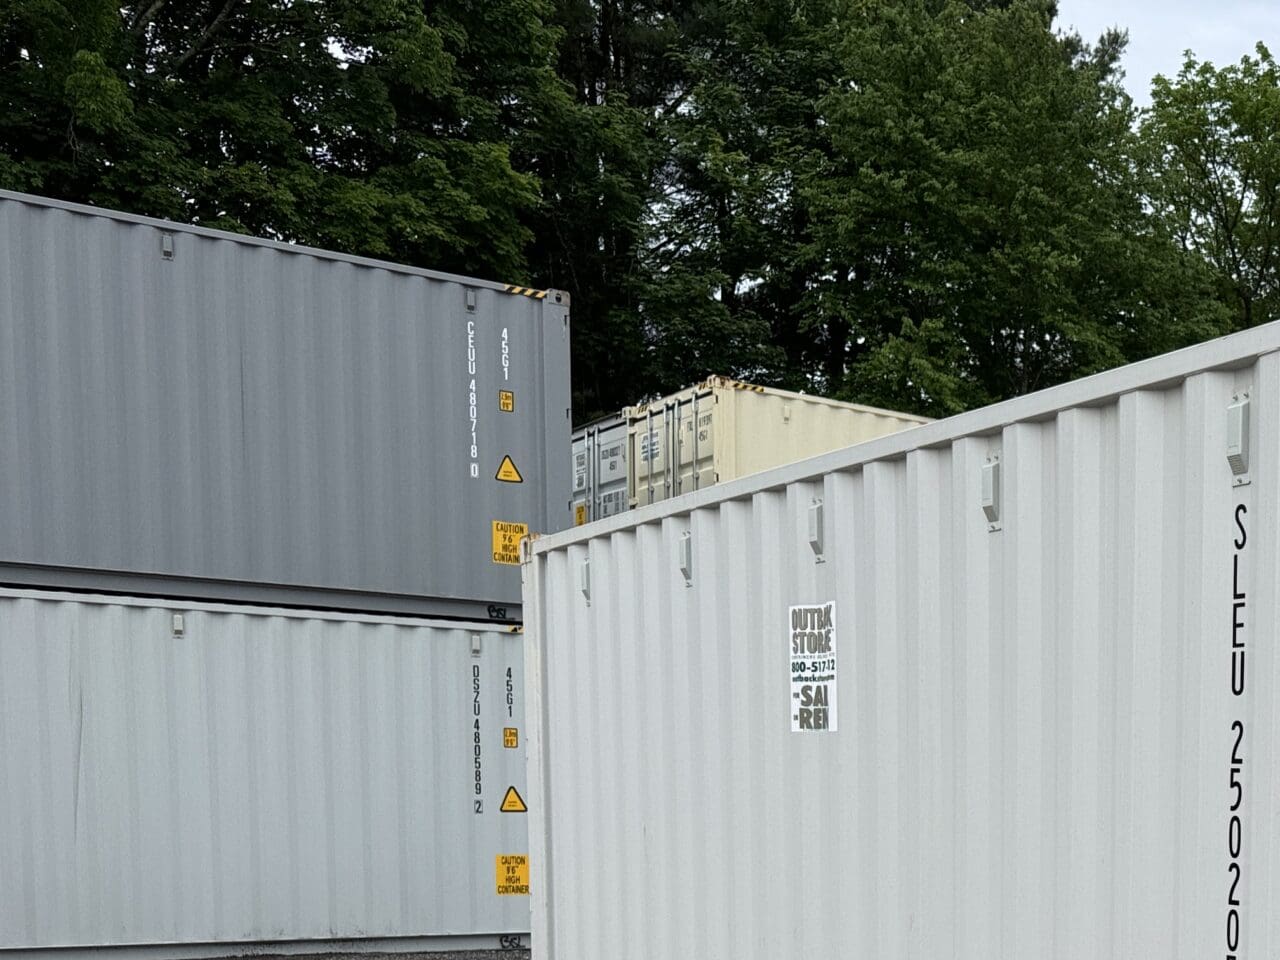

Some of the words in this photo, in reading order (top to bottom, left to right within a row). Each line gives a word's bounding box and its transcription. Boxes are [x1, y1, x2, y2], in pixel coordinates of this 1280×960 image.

[501, 327, 510, 380] 45G1
[469, 379, 478, 459] 480718
[495, 522, 524, 535] CAUTION
[501, 544, 517, 554] HIGH
[493, 551, 520, 562] CONTAIN
[1231, 503, 1248, 697] SLEU
[472, 665, 481, 716] DSZU
[506, 667, 514, 717] 45G1
[473, 718, 482, 795] 480589
[501, 855, 526, 865] CAUTION
